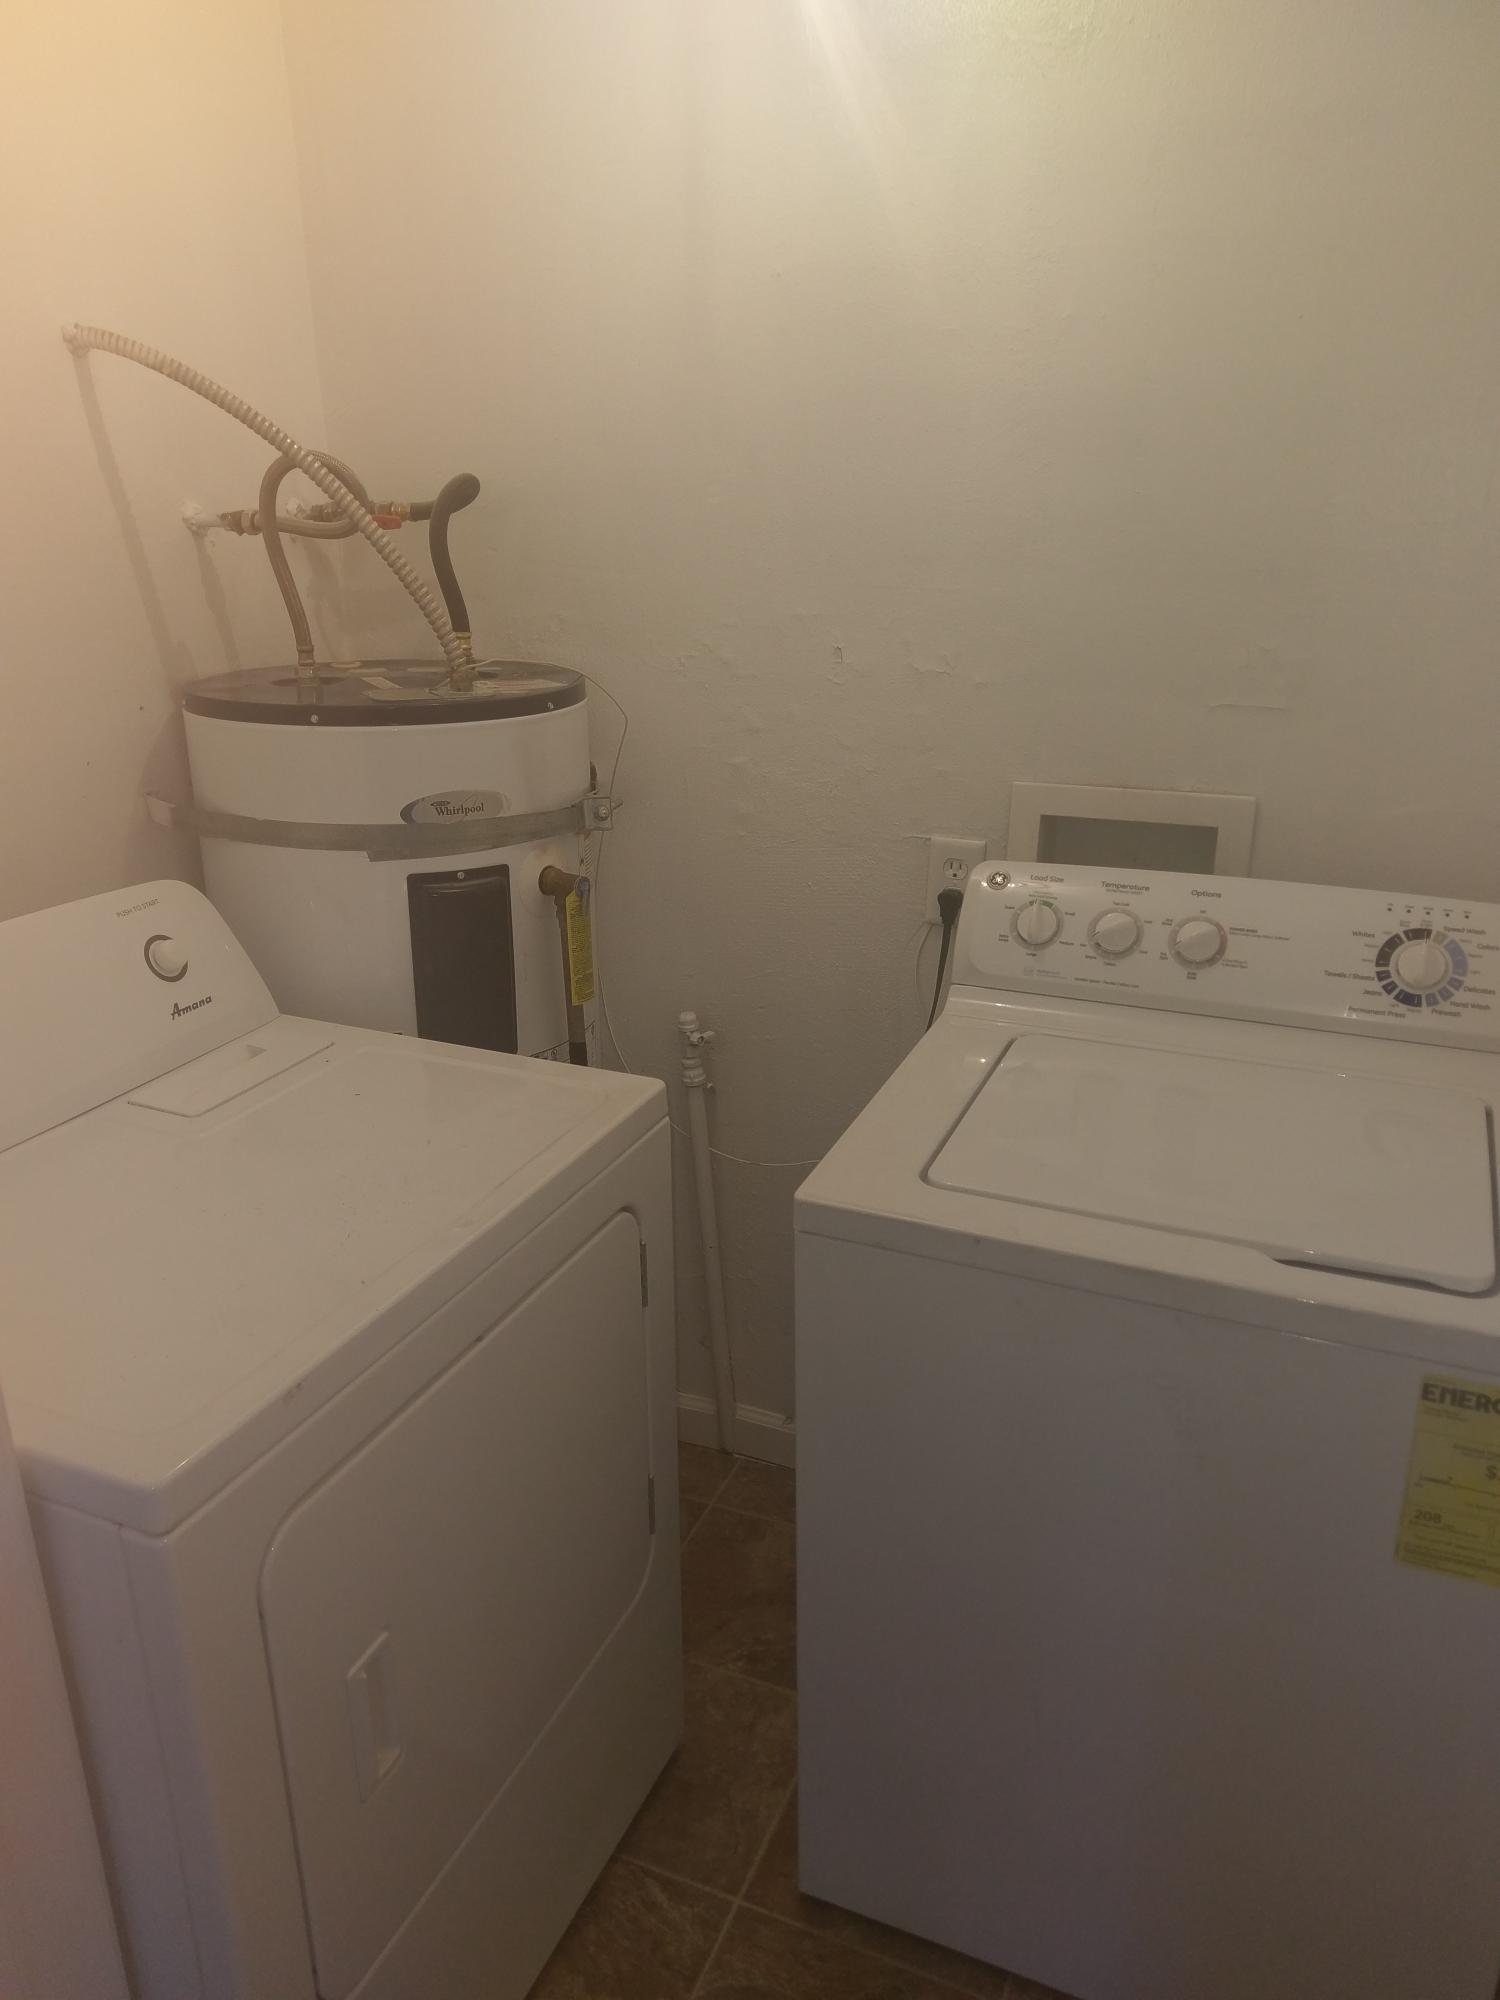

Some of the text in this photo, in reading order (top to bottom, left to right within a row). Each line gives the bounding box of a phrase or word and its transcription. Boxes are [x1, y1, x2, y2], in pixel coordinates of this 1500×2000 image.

[434, 802, 485, 817] Whirlpool
[1030, 874, 1049, 882] Load
[1101, 881, 1150, 892] Temperature
[1191, 889, 1222, 899] Options
[1352, 930, 1375, 938] Whites
[1466, 927, 1486, 936] Wash
[1463, 986, 1496, 996] Delicates
[170, 995, 212, 1021] Amana
[1450, 1000, 1491, 1011] Hand Wash
[1413, 1509, 1442, 1524] 208
